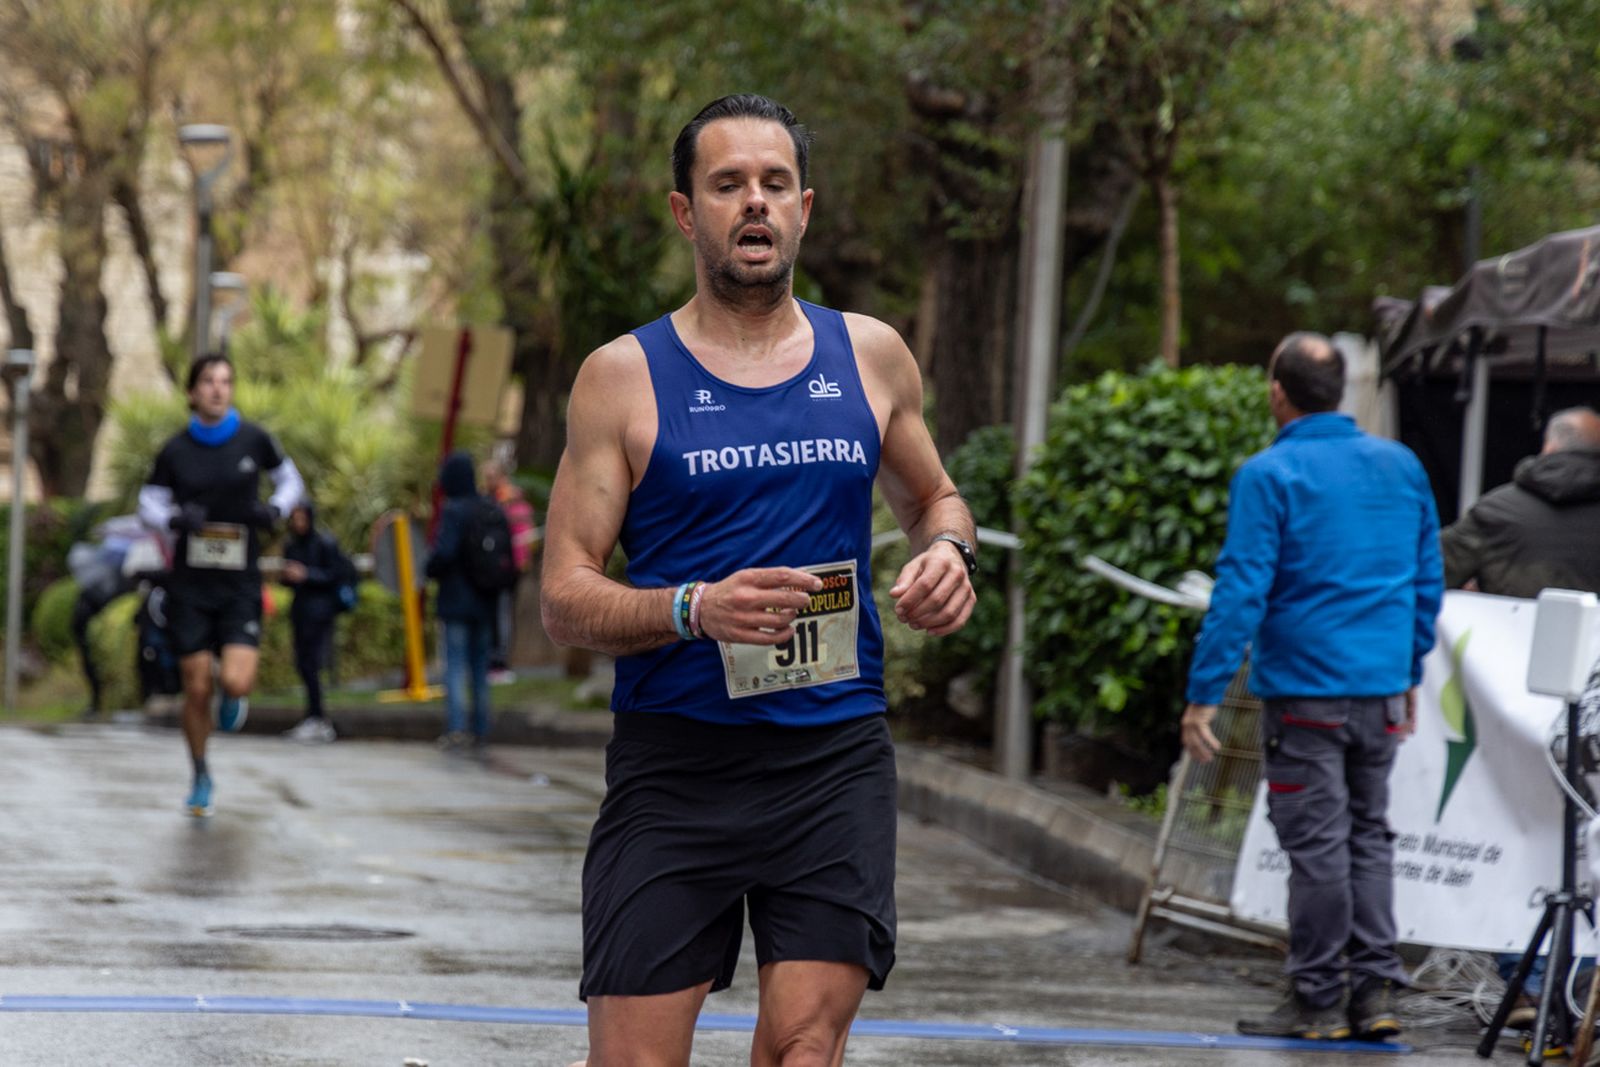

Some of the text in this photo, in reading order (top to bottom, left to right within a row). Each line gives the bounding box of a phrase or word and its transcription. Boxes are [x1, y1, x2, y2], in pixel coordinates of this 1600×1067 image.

[682, 438, 867, 476] TROTASIERRA
[822, 576, 848, 589] OSCO
[775, 621, 818, 667] 911
[1423, 834, 1484, 862] Municipal
[1482, 845, 1503, 864] de
[1393, 861, 1422, 880] ortes
[1424, 865, 1443, 884] de
